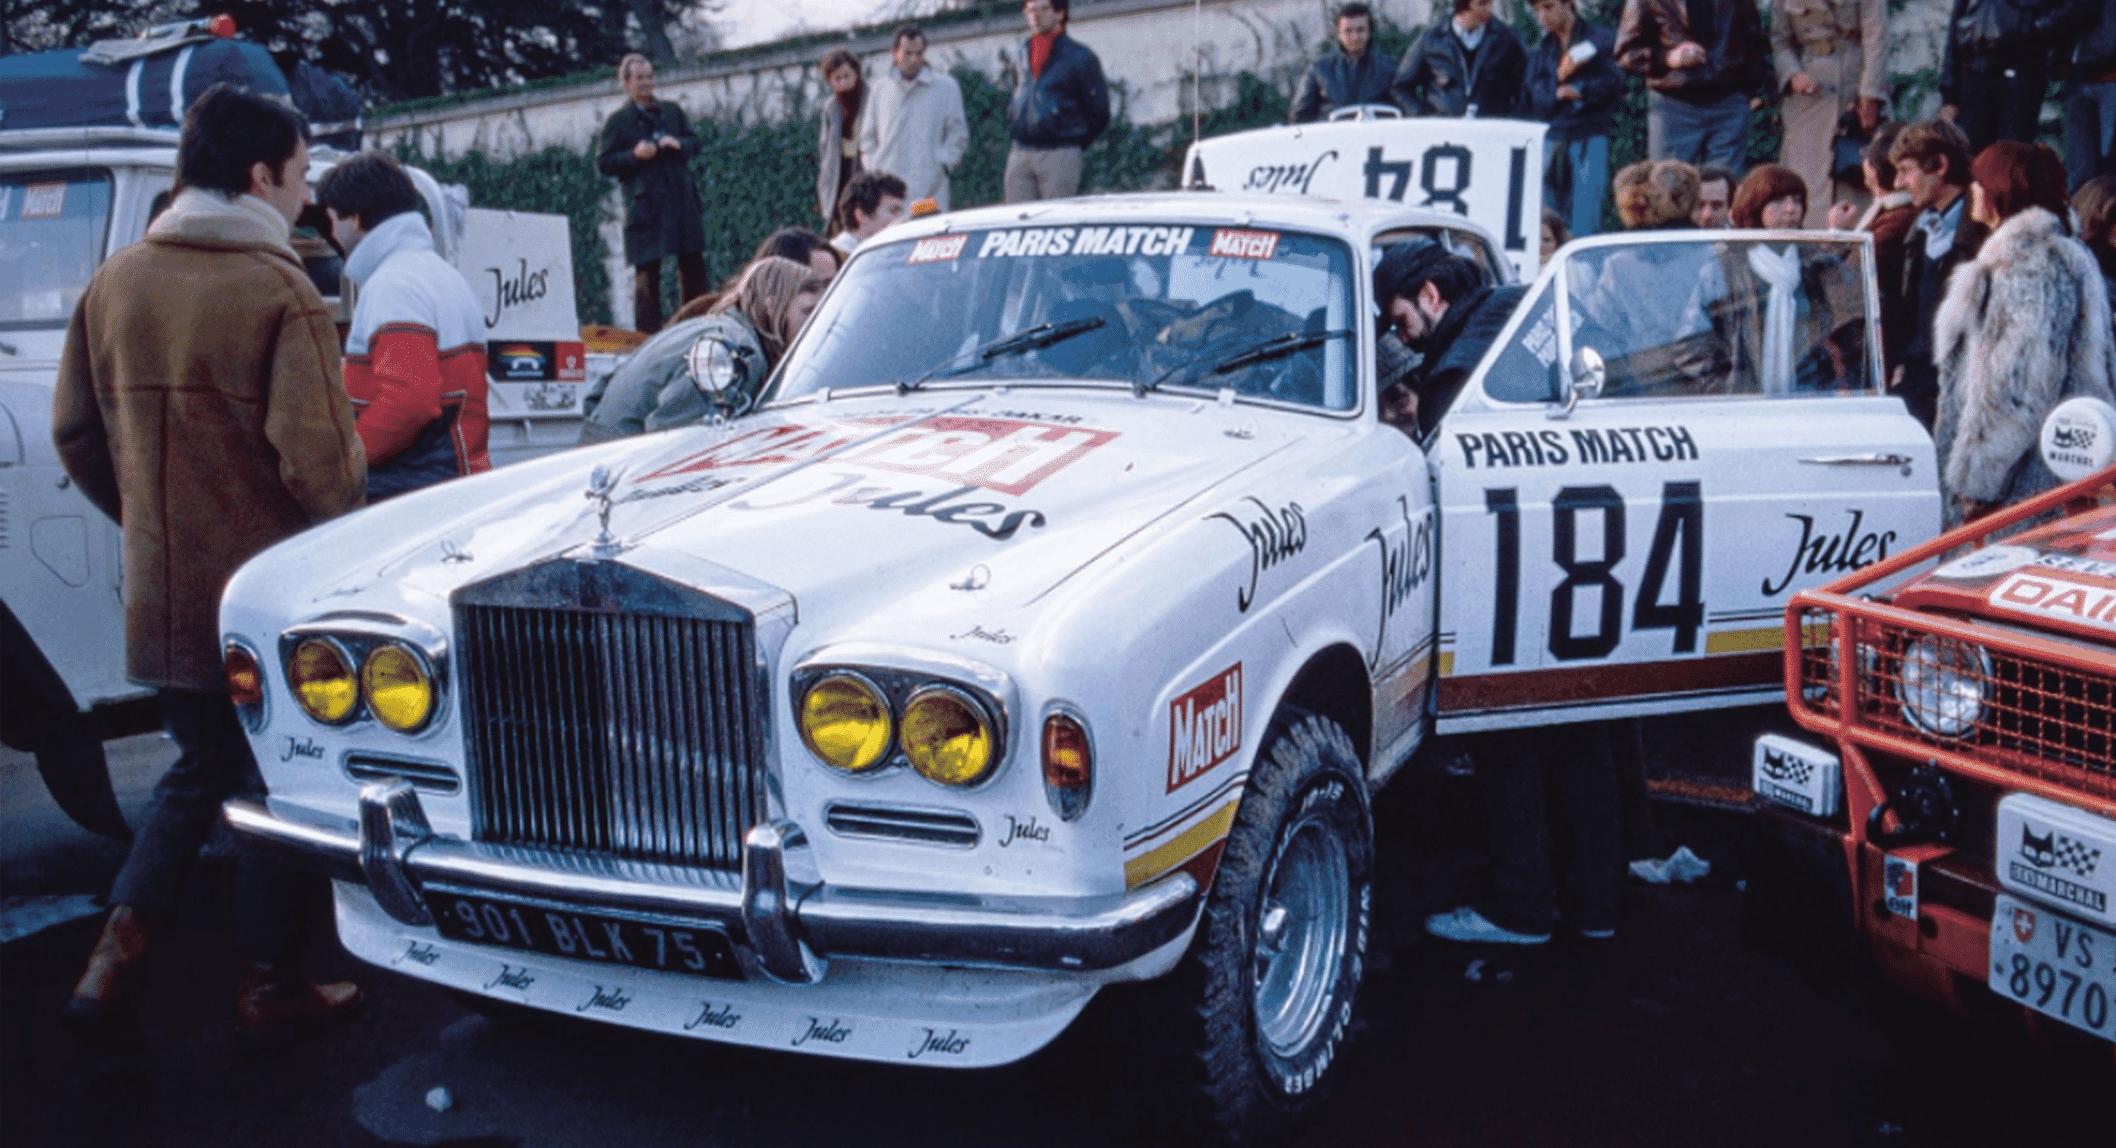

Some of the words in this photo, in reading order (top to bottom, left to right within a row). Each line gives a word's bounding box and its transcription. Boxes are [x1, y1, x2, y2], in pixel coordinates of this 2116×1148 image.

[1243, 149, 1339, 194] Jules
[979, 229, 1074, 258] PARIS
[1072, 227, 1195, 257] MATCH
[1213, 231, 1277, 257] MATCH
[485, 259, 549, 328] Jules
[1457, 431, 1568, 468] PARIS
[1572, 427, 1701, 464] MATCH
[728, 472, 1046, 541] Jules
[1202, 496, 1307, 613] Jules
[1484, 480, 1705, 667] 184
[1762, 510, 1896, 596] Jules
[1364, 494, 1432, 673] Jules
[1172, 669, 1240, 784] MATCH
[281, 737, 326, 762] Jules
[999, 815, 1051, 847] Jules
[2037, 874, 2103, 910] MARCHAL
[393, 940, 441, 967] Jules
[459, 901, 532, 948] 901
[546, 913, 636, 963] BLK
[644, 928, 706, 970] 75
[2055, 921, 2094, 968] VS
[484, 964, 535, 991] Jules
[577, 984, 631, 1012] Jules
[2010, 953, 2116, 1030] 8970
[684, 1002, 741, 1029] Jules
[791, 1016, 851, 1045] Jules
[907, 1028, 971, 1059] Jules
